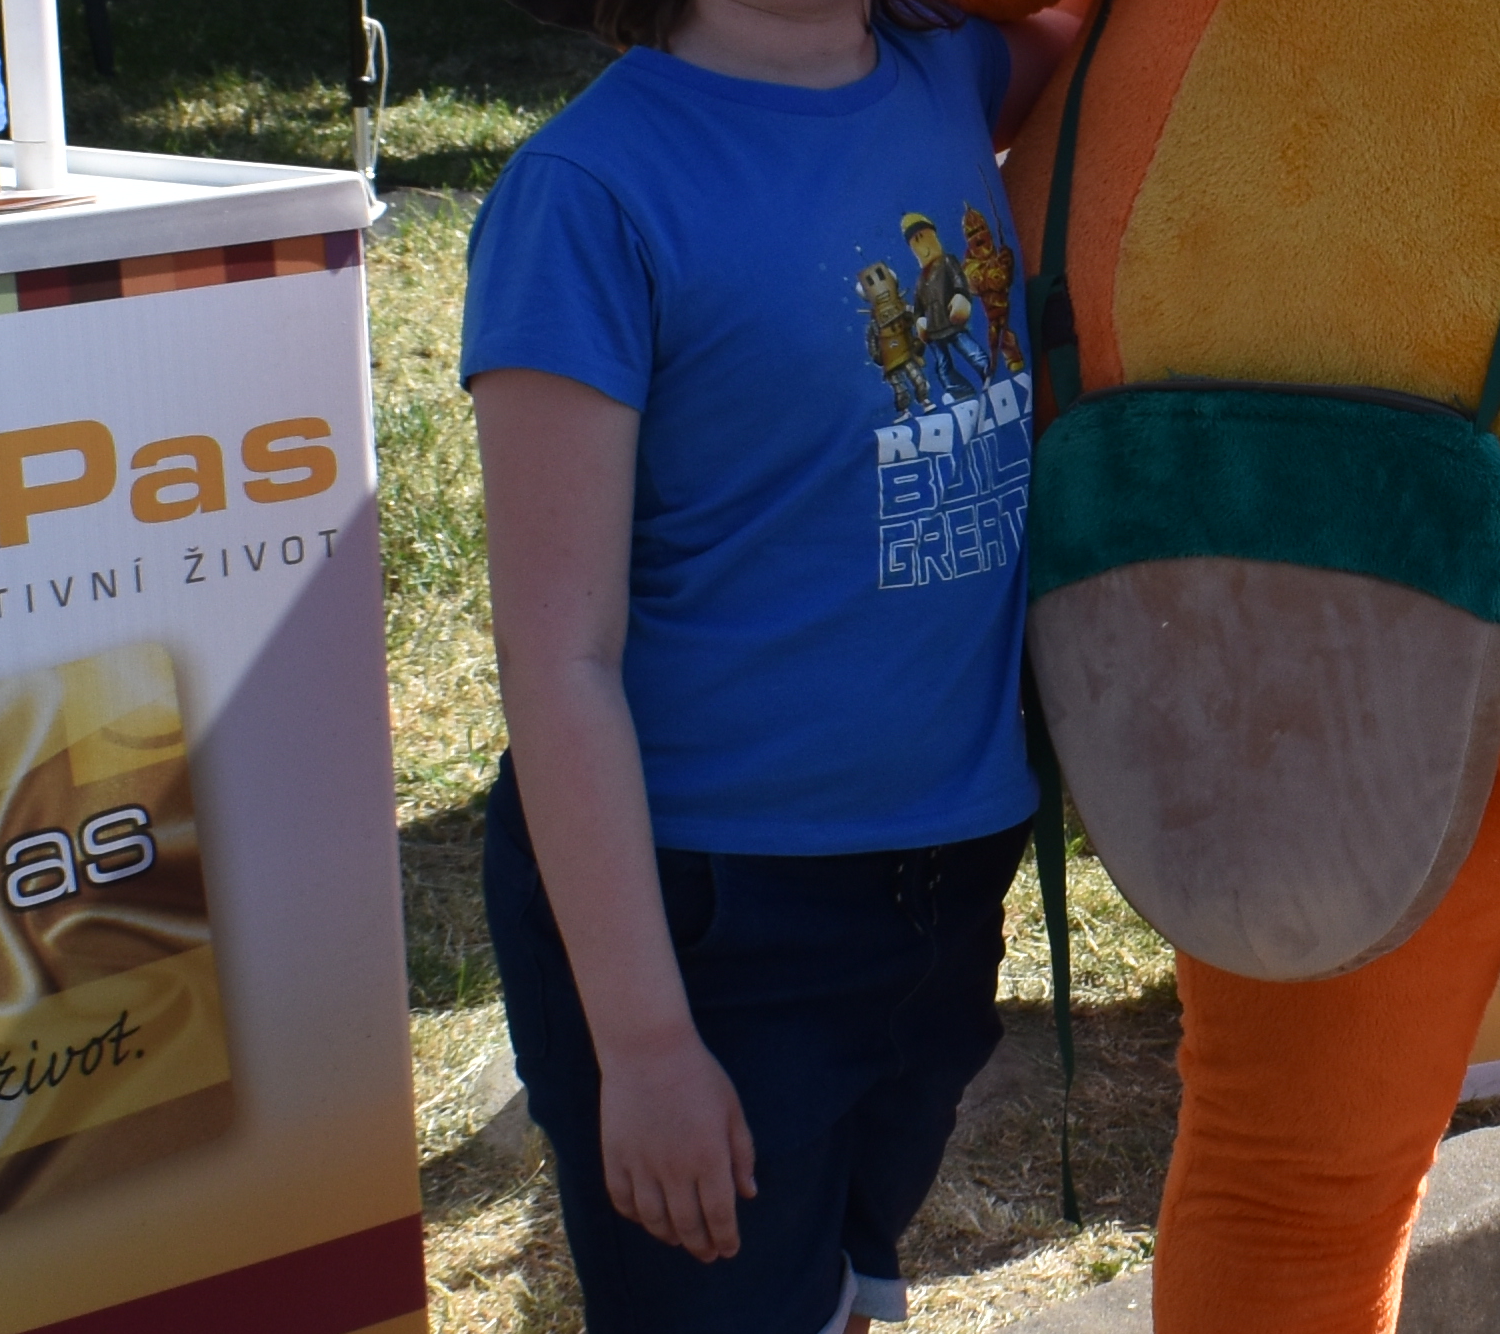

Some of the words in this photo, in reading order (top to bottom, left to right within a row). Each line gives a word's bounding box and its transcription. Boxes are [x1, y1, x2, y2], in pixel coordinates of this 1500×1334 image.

[879, 417, 1031, 519] BUIL
[184, 528, 339, 585] ŽIVOT
[879, 485, 1028, 590] GREAT
